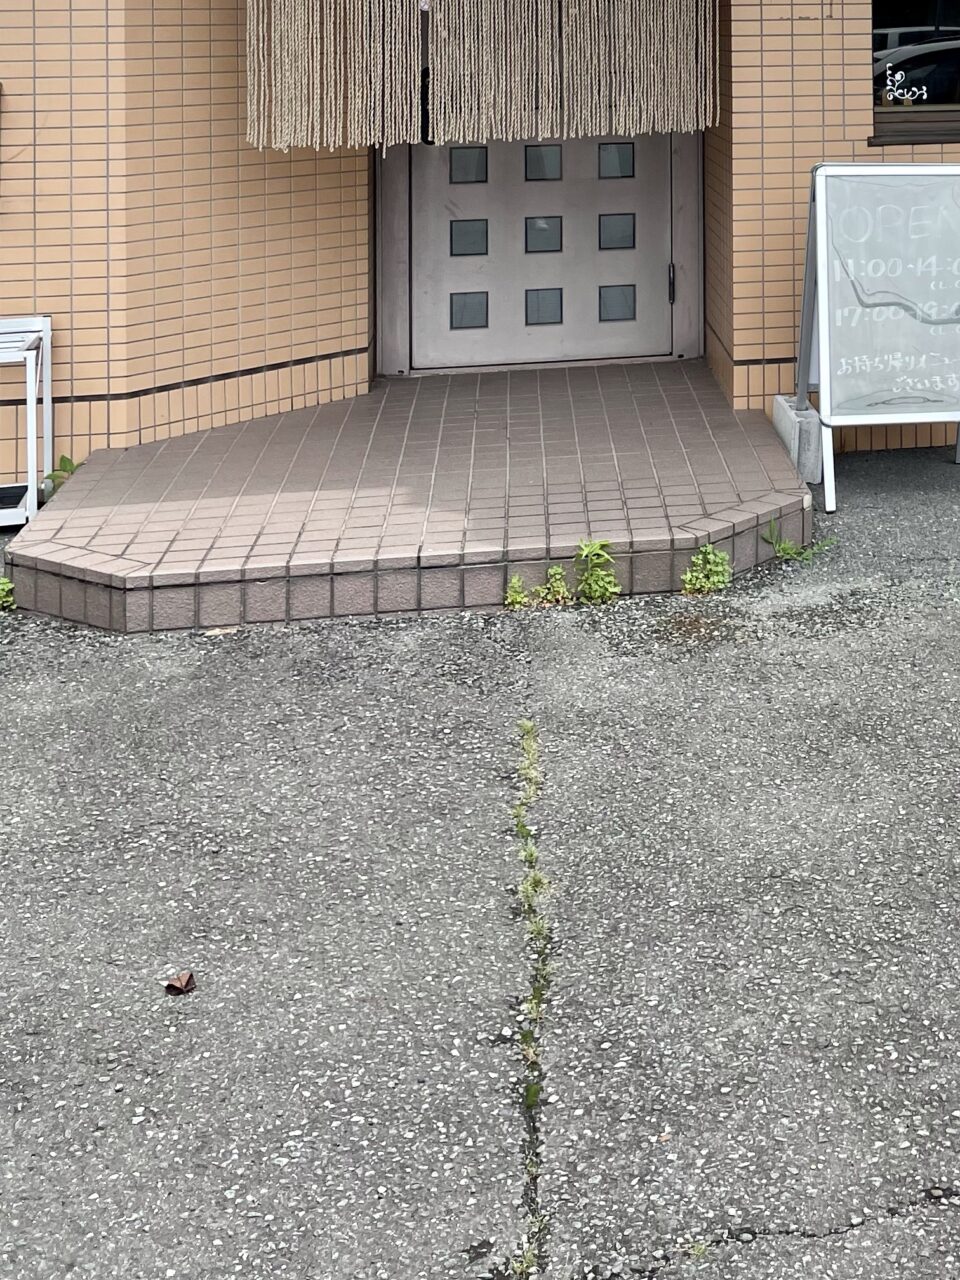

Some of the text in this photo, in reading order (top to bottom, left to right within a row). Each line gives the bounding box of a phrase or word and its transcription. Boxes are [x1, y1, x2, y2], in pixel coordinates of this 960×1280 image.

[892, 373, 960, 393] ございます
